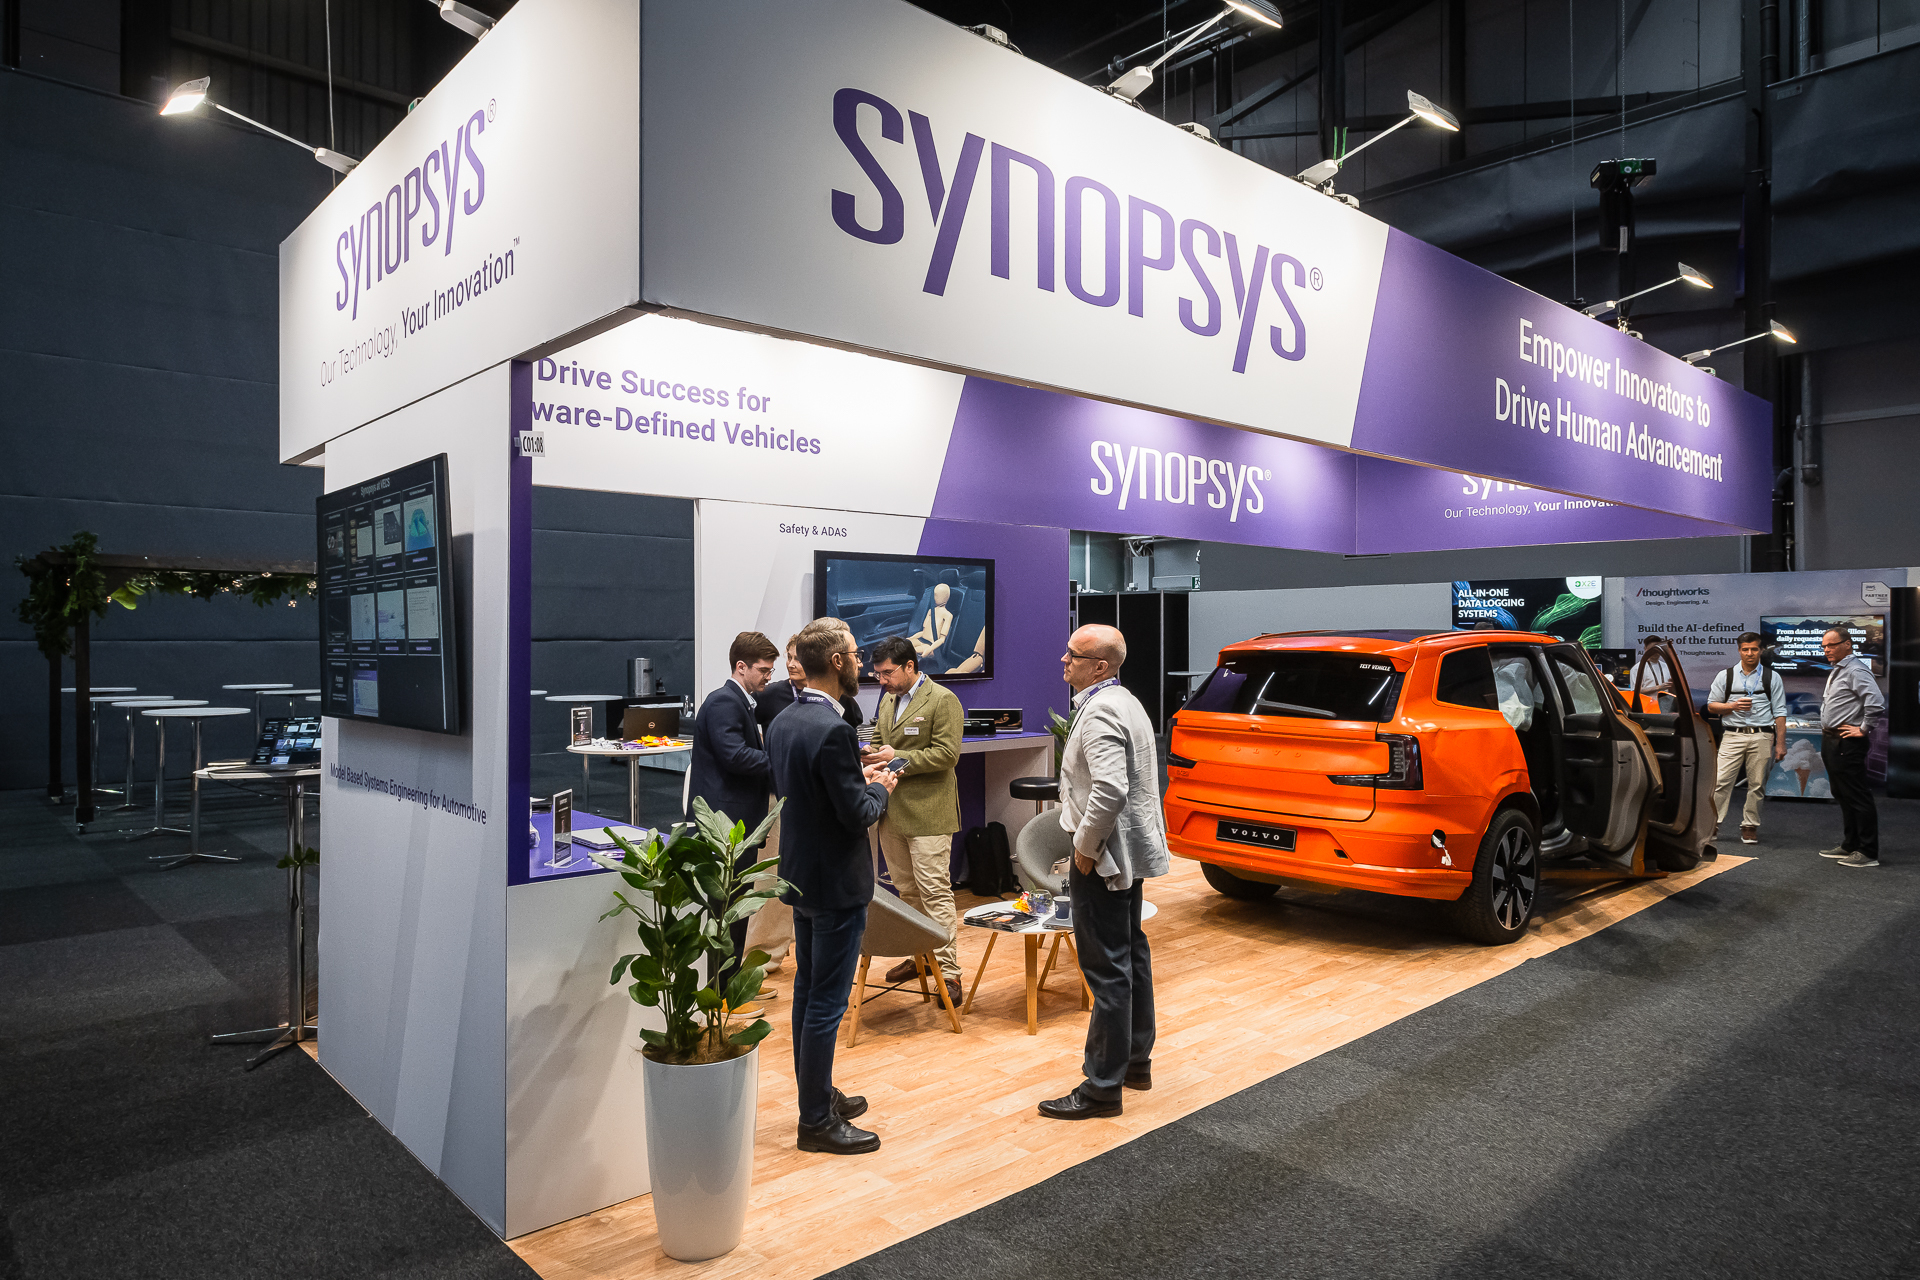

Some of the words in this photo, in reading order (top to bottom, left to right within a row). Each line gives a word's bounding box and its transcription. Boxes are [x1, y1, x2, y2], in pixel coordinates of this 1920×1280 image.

[321, 361, 336, 387] Our
[339, 323, 398, 375] Technology,
[402, 307, 430, 338] Your
[1519, 317, 1612, 390] Empower
[1615, 358, 1694, 422] Innovators
[1697, 395, 1711, 428] to
[537, 358, 612, 390] Drive
[621, 369, 730, 408] Success
[737, 387, 771, 413] for
[723, 420, 821, 454] Vehicles
[1495, 377, 1551, 434] Drive
[1556, 398, 1622, 453] Human
[1625, 421, 1723, 483] Advancement
[523, 436, 543, 453] C01:08
[1445, 508, 1464, 519] Our
[1466, 504, 1531, 517] Technology,
[1534, 501, 1561, 511] Your
[779, 523, 810, 537] Safety
[812, 525, 819, 535] &
[821, 526, 847, 537] ADAS
[1458, 588, 1509, 598] ALL-IN-ONE
[1458, 599, 1483, 607] DATA
[1483, 598, 1525, 607] LOGGING
[1458, 609, 1497, 618] SYSTEMS
[1638, 623, 1665, 632] Build
[1666, 623, 1684, 632] the
[1686, 622, 1744, 632] AI-defined
[1676, 635, 1687, 644] of
[1689, 635, 1706, 644] the
[1708, 635, 1738, 644] futur
[1777, 635, 1794, 643] daily
[330, 762, 346, 780] Model
[347, 766, 363, 786] Based
[364, 771, 388, 792] Systems
[390, 778, 428, 810] Engineering
[430, 789, 441, 809] for
[441, 794, 487, 825] Automotive
[1231, 828, 1280, 841] VOLVO
